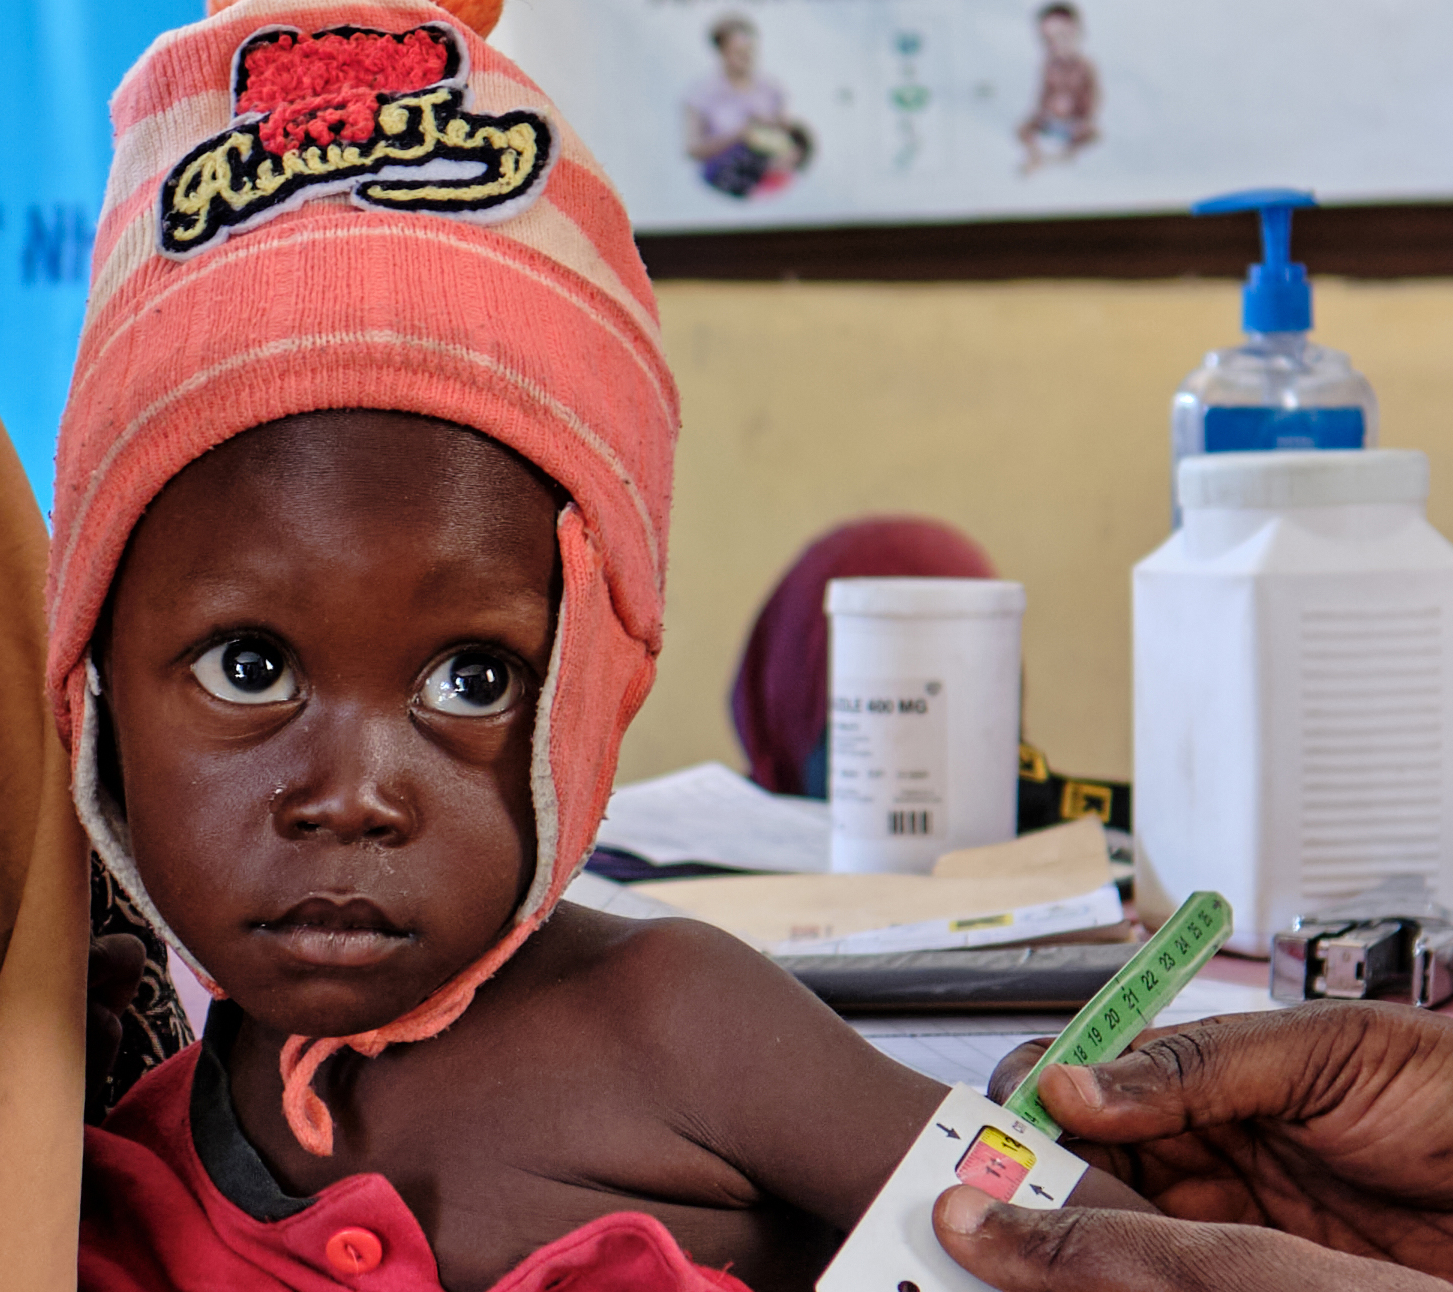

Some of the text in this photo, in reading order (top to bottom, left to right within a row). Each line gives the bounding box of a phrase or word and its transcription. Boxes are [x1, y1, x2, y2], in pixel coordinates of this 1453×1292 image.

[898, 697, 928, 715] MG
[1073, 1044, 1089, 1064] 18
[1087, 1026, 1103, 1047] 19
[1104, 1007, 1121, 1030] 20
[1122, 988, 1140, 1010] 21
[1141, 970, 1159, 991] 22
[1158, 951, 1176, 972] 23
[1174, 935, 1192, 955] 24
[1187, 921, 1203, 940] 25
[1197, 909, 1214, 928] 26
[1001, 1136, 1022, 1153] 12
